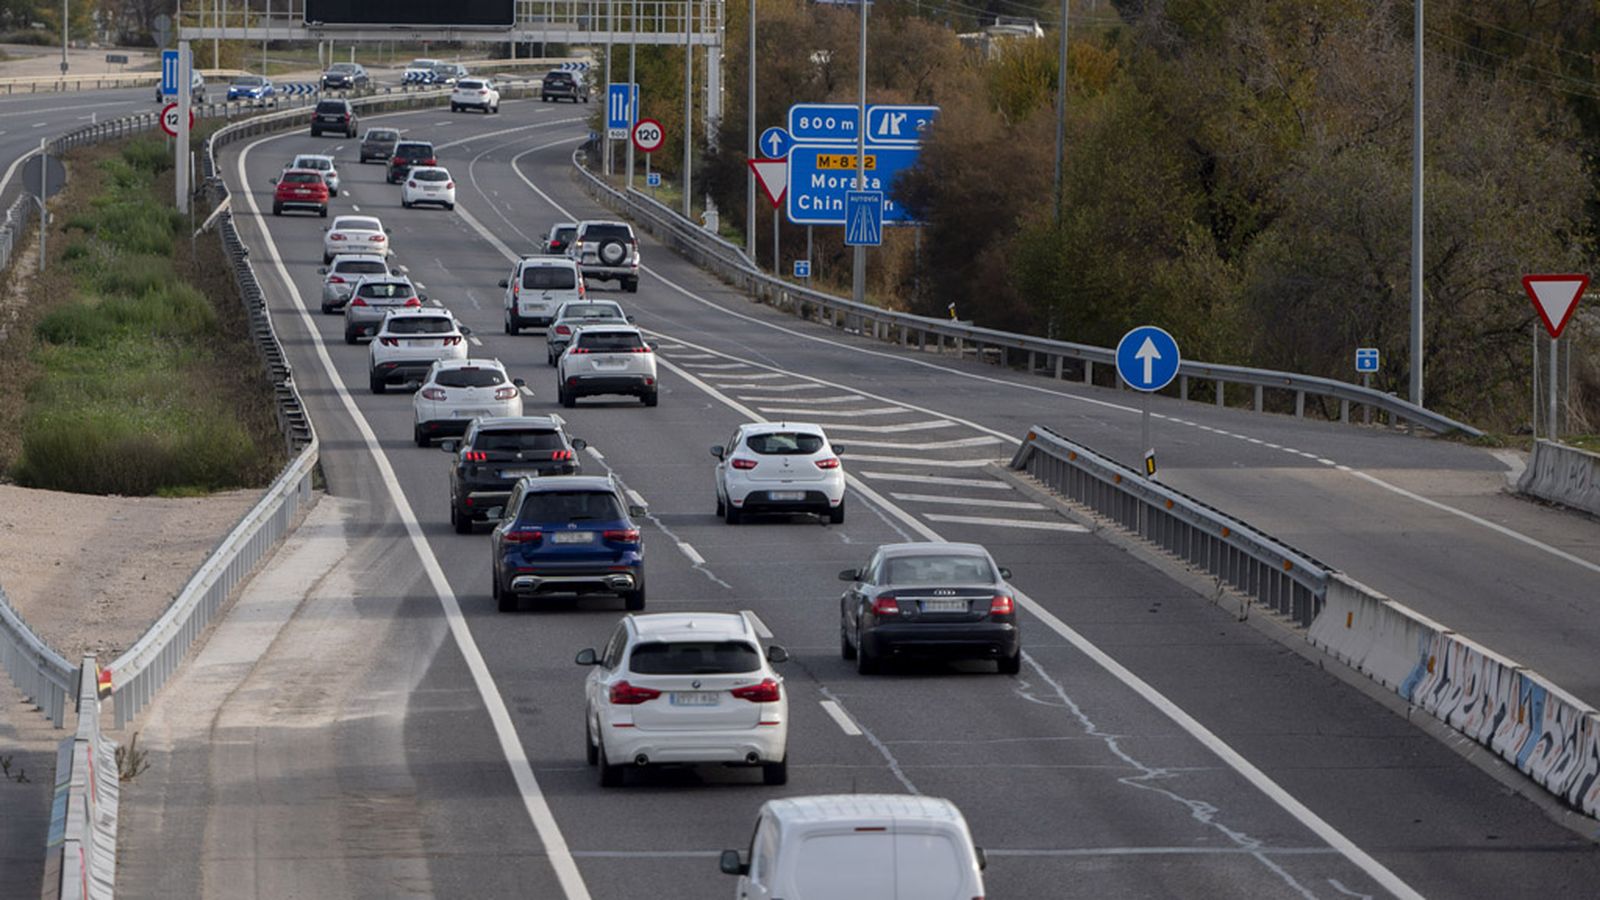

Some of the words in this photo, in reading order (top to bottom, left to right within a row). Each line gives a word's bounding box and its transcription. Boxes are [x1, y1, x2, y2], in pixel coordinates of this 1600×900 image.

[799, 117, 836, 130] 800
[841, 120, 854, 130] m
[638, 129, 659, 140] 120
